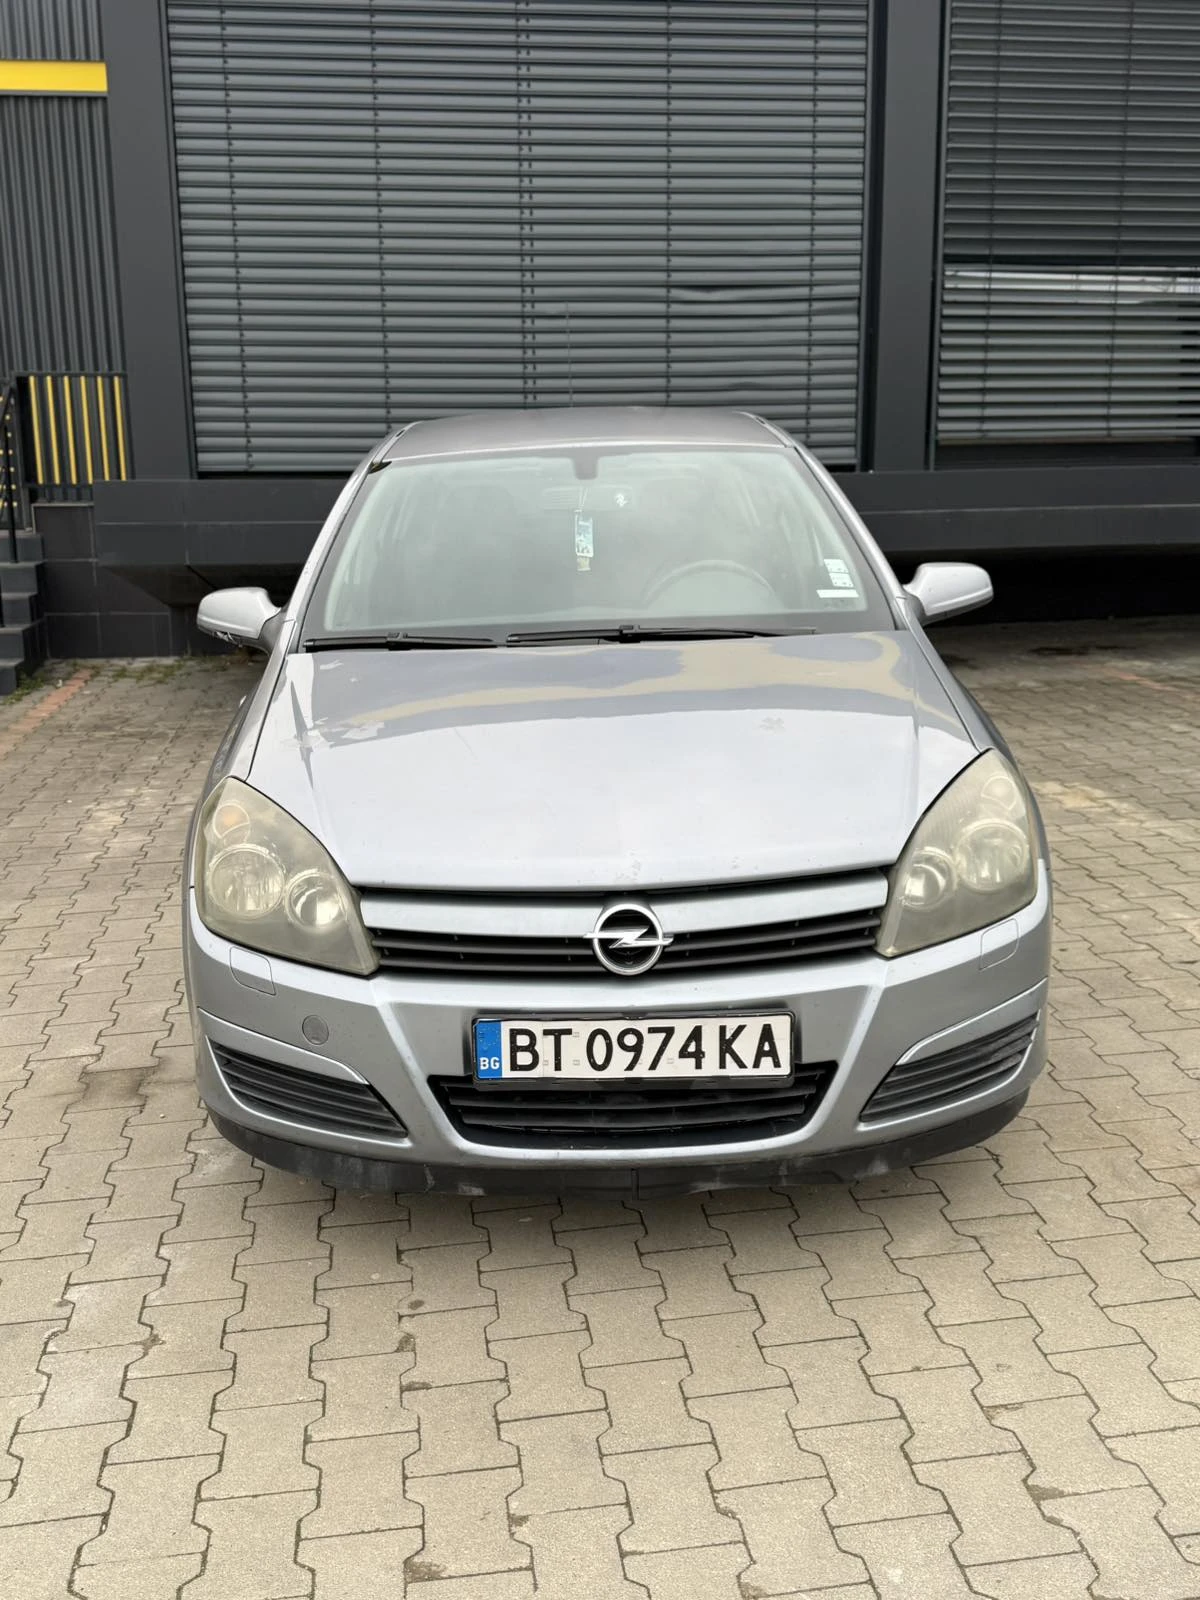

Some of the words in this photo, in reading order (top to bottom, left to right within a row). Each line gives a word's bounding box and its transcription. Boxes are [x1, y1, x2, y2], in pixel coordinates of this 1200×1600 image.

[509, 1028, 573, 1071] BT
[586, 1025, 705, 1071] 0974
[718, 1024, 782, 1069] KA
[480, 1057, 500, 1070] BG
